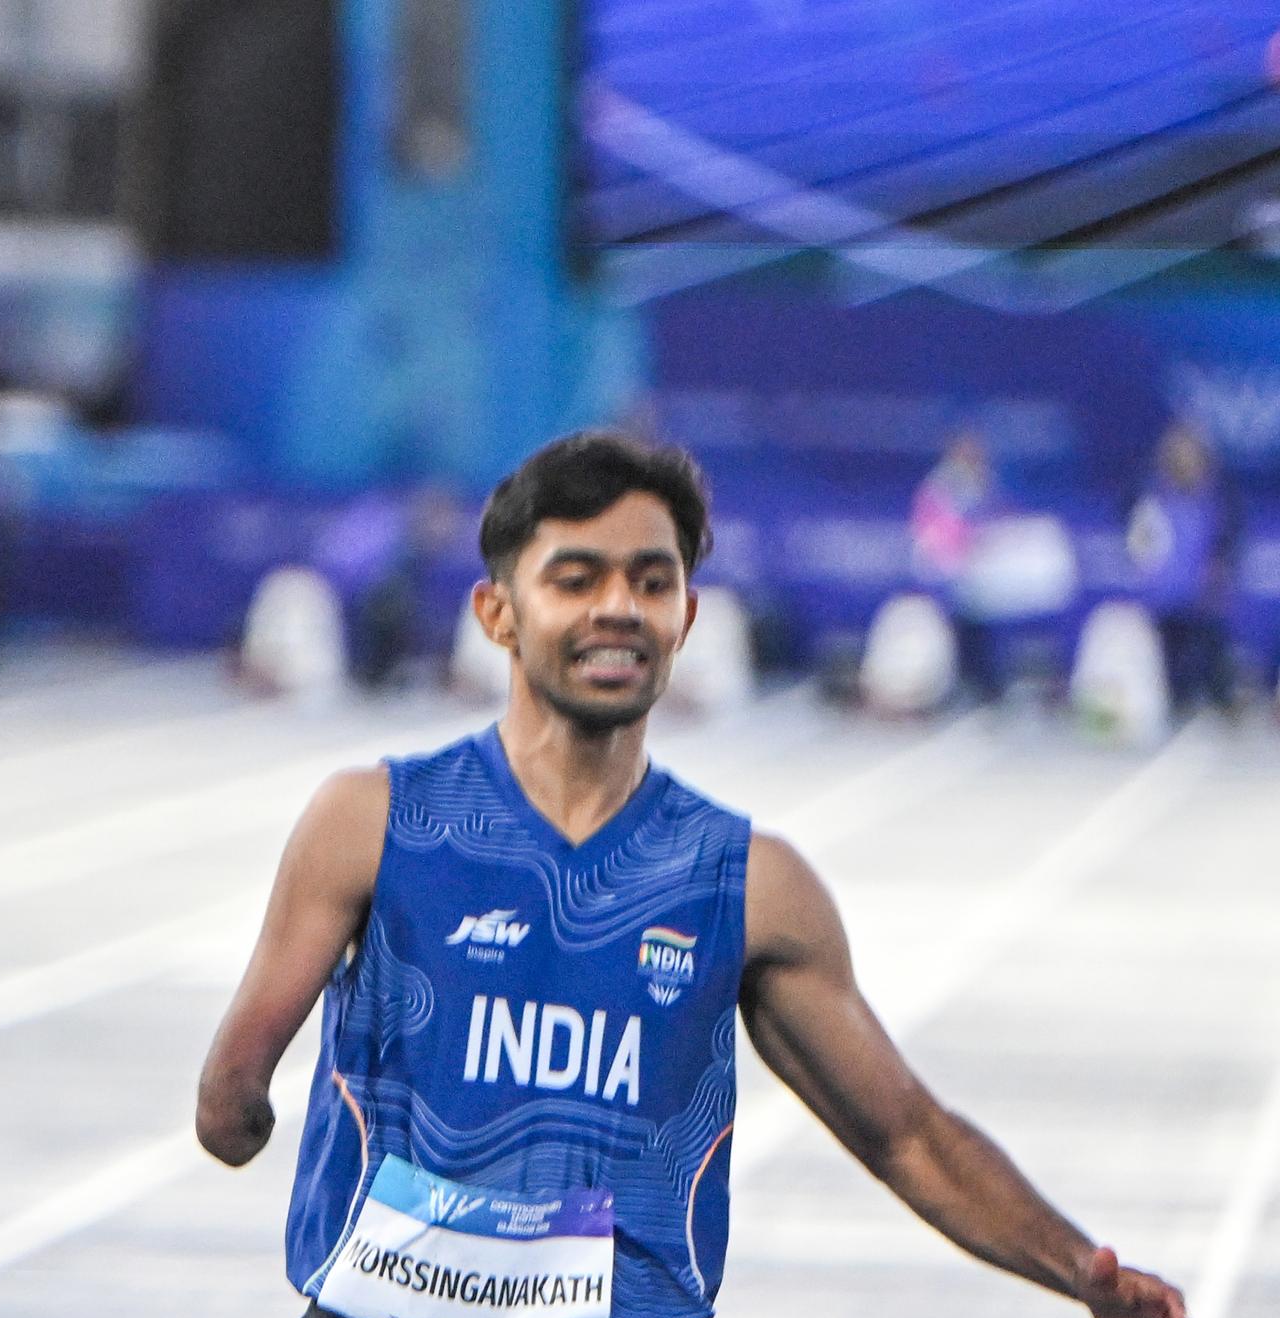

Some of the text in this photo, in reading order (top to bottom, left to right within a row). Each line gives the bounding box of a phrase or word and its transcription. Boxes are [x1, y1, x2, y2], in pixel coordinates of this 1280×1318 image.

[445, 909, 530, 946] JSW
[639, 943, 694, 977] INDIA
[462, 994, 641, 1106] INDIA
[344, 1237, 604, 1308] MORSSINGANAKATH
